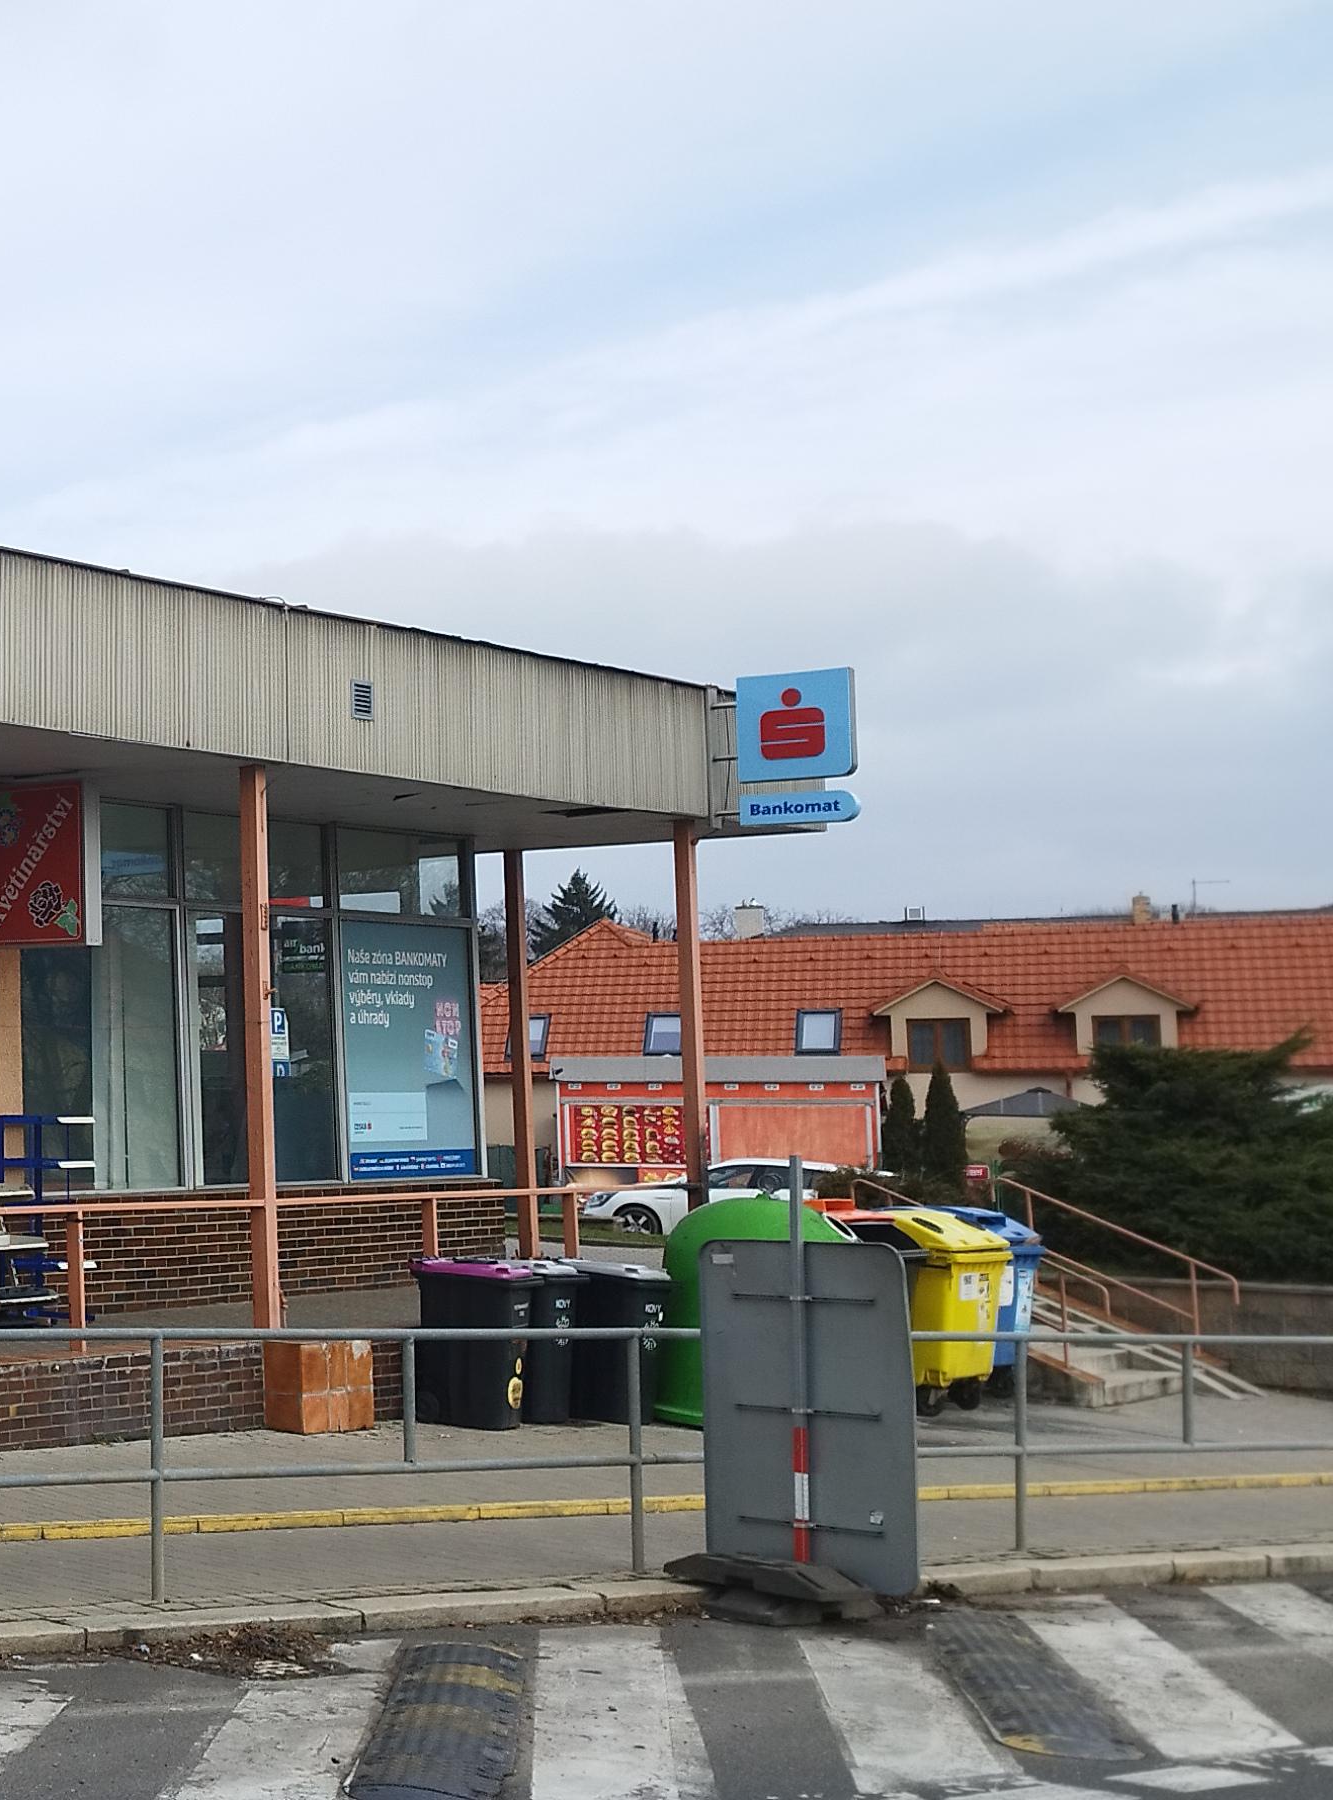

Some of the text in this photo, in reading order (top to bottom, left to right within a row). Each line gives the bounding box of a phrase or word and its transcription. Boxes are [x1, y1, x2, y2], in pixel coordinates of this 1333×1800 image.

[749, 799, 841, 816] Bankomat
[347, 949, 447, 967] Naše zóna BANKOMATY
[348, 969, 369, 984] vám
[398, 973, 433, 988] nonstop
[350, 1009, 389, 1028] a úhrady
[555, 1299, 571, 1309] KOVY
[645, 1304, 662, 1313] KOVY
